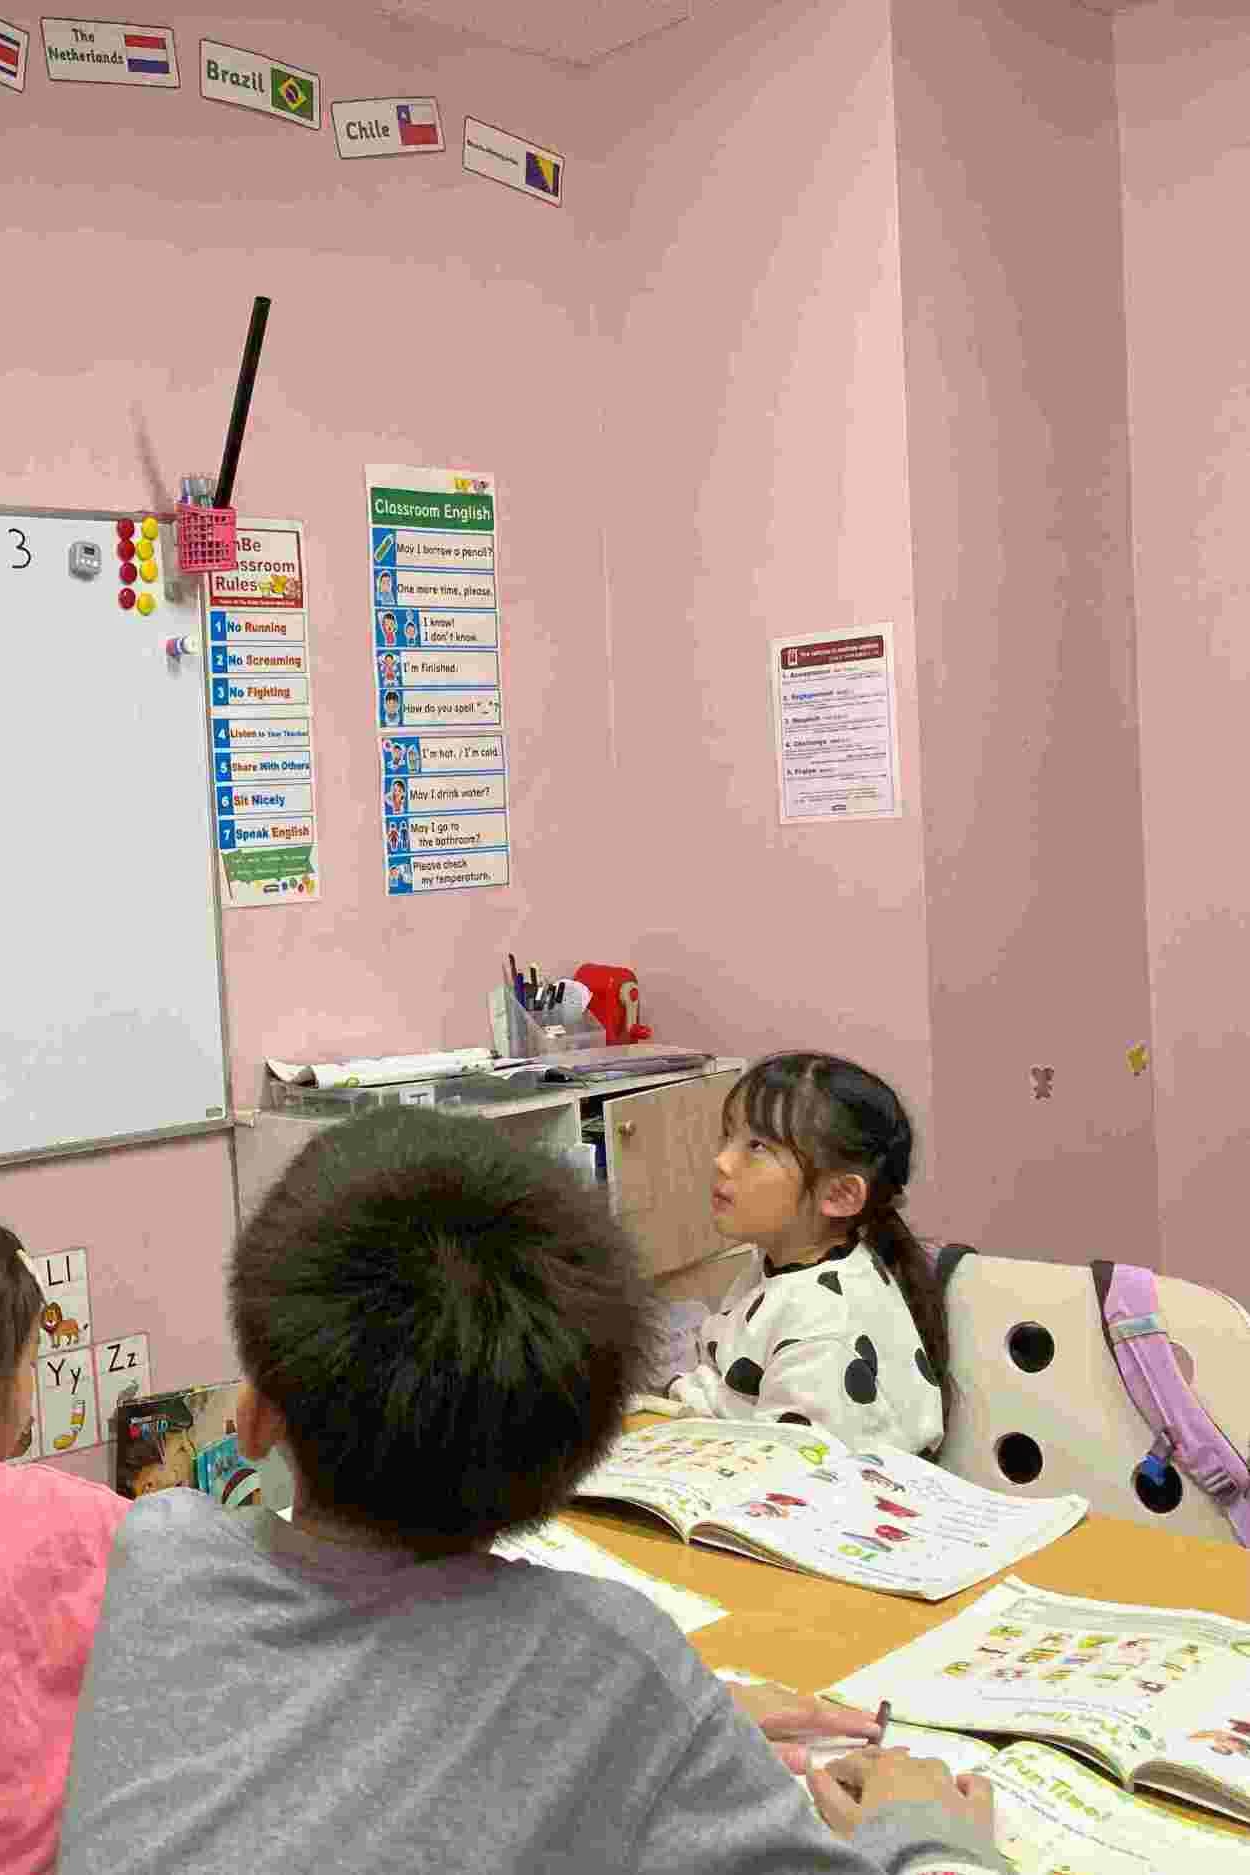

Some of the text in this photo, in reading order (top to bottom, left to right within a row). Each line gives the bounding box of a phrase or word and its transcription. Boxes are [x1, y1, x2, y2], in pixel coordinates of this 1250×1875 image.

[71, 28, 95, 42] The
[47, 45, 125, 65] Netherlands
[206, 59, 266, 94] Brazil
[345, 119, 391, 142] Chile
[374, 498, 492, 524] Classroom English
[397, 543, 415, 555] May
[422, 543, 453, 556] borrow
[461, 545, 494, 560] pencil?
[215, 575, 258, 592] Rules
[397, 583, 415, 594] One
[416, 585, 439, 595] more
[215, 620, 288, 636] 1 No Running
[422, 616, 429, 627] I
[423, 631, 429, 642] I
[228, 654, 243, 667] No
[245, 653, 303, 669] Screaming
[403, 661, 420, 673] I'm
[229, 686, 245, 699] No
[247, 685, 292, 700] Fighting
[403, 703, 423, 714] How
[424, 702, 436, 714] do
[437, 704, 453, 717] you
[453, 702, 475, 716] spell
[217, 728, 227, 741] 4
[422, 747, 438, 759] I'm
[464, 745, 480, 758] I'm
[219, 761, 229, 774] 5
[259, 760, 280, 771] With
[281, 759, 310, 770] Others
[221, 793, 286, 808] 6 Sit Nicely
[410, 785, 491, 801] May I drink water?
[222, 826, 310, 842] 7 Speak English
[410, 821, 460, 834] May I go to
[418, 831, 481, 848] the bathroom?
[413, 858, 469, 872] Please check
[106, 1343, 138, 1373] Zz
[47, 1358, 82, 1395] Yy
